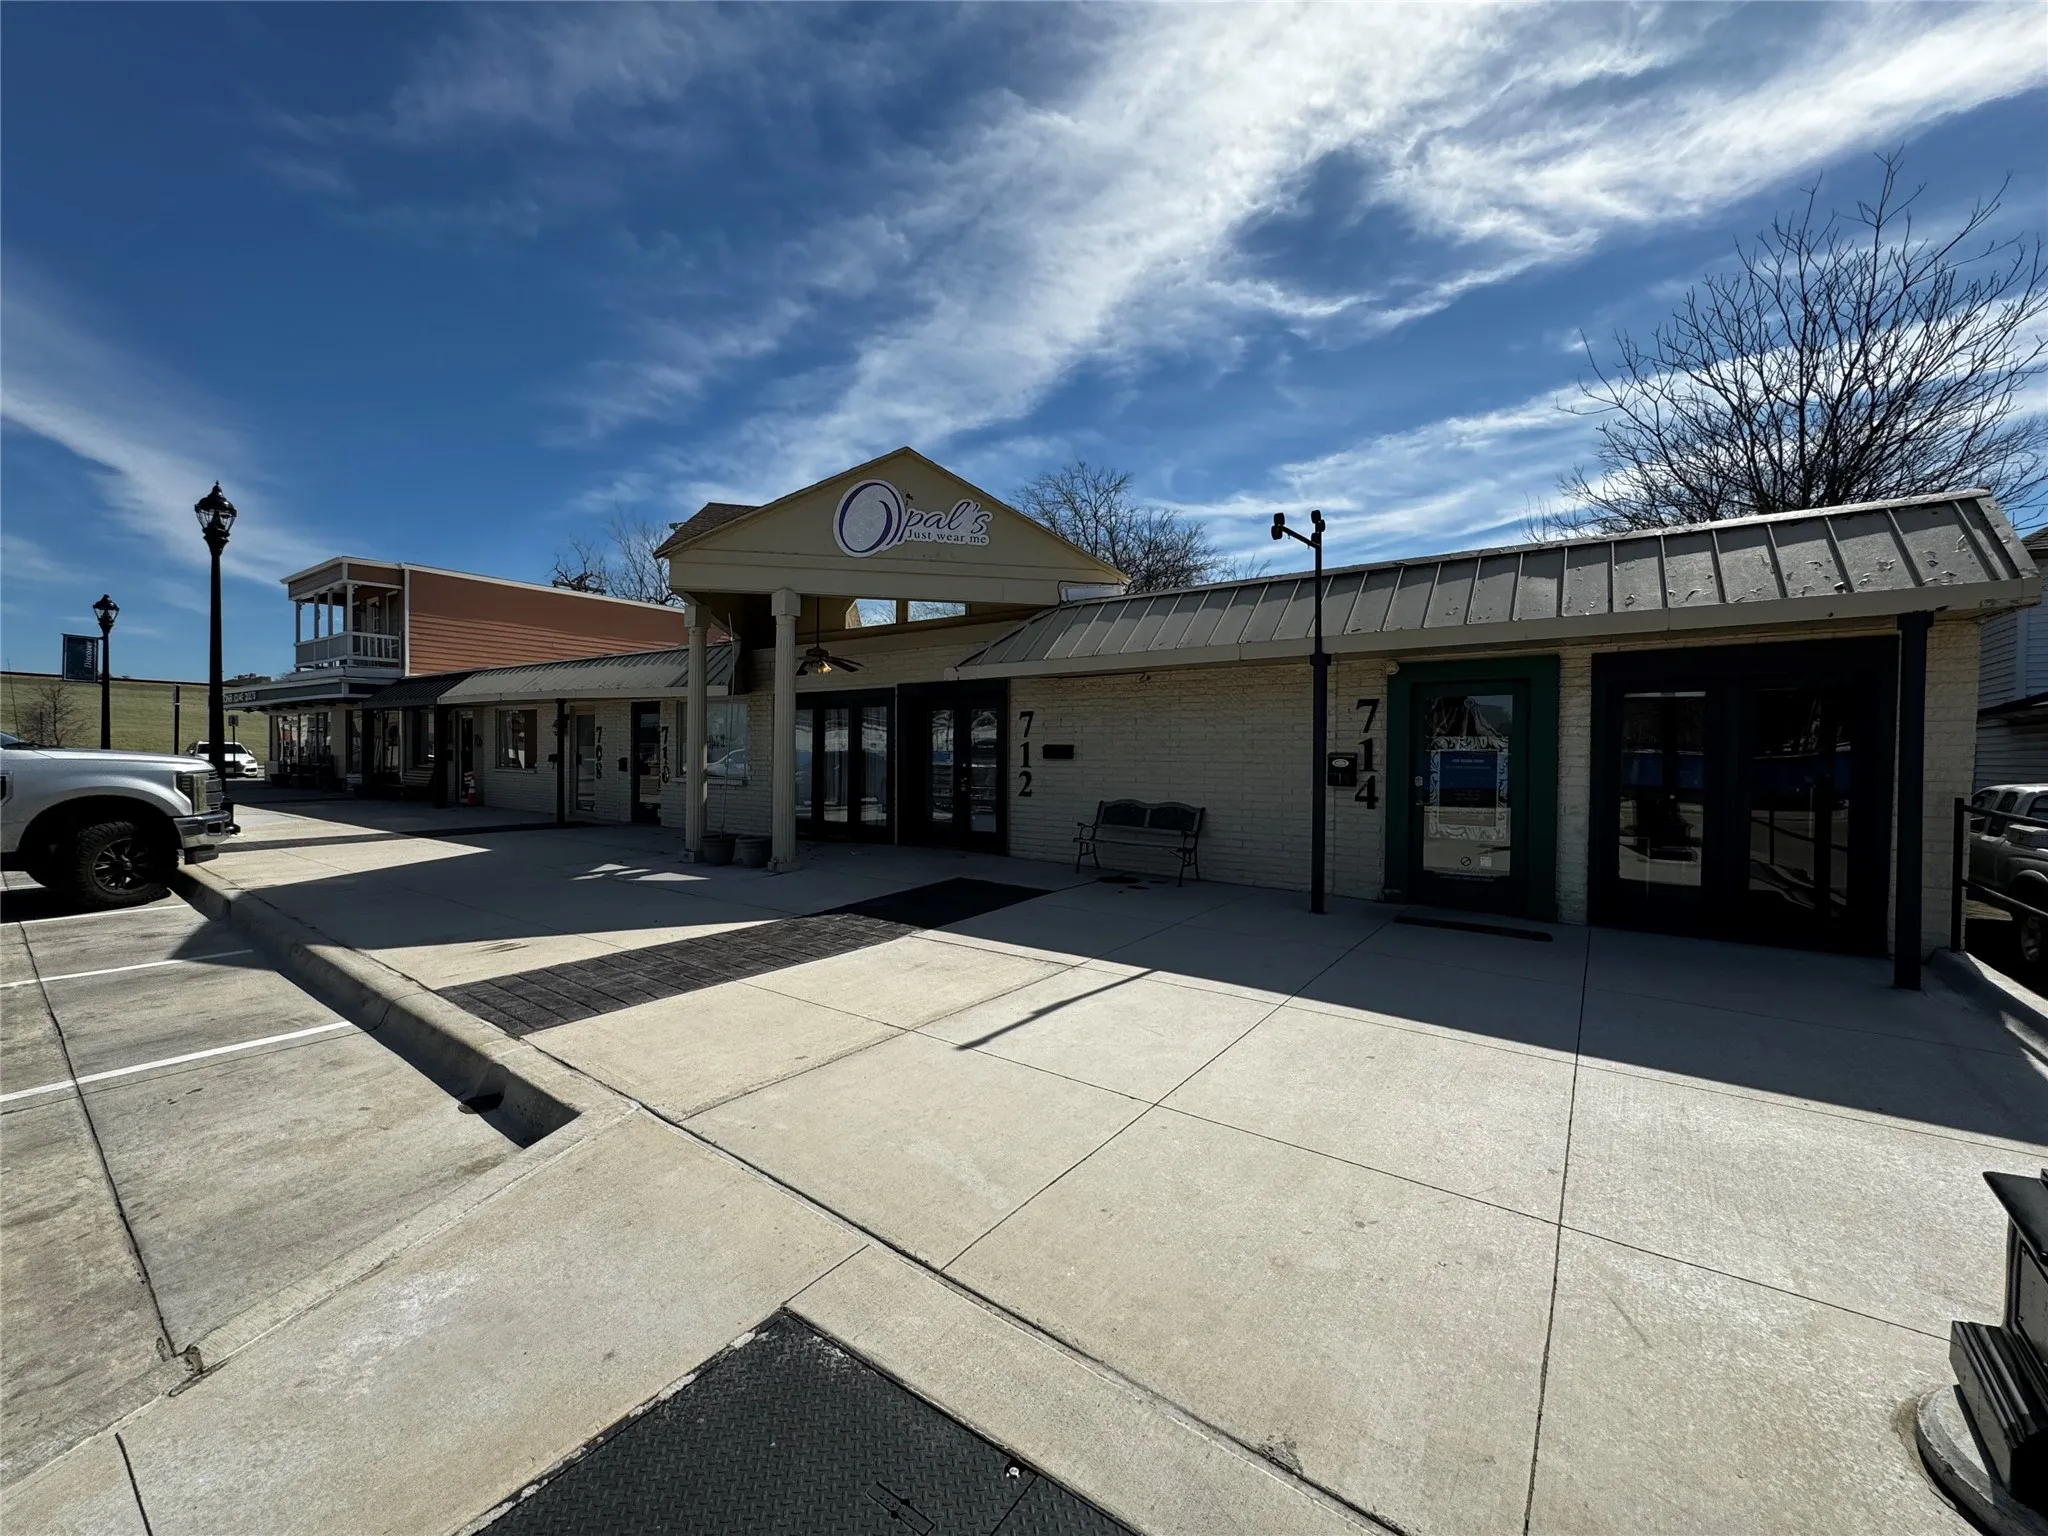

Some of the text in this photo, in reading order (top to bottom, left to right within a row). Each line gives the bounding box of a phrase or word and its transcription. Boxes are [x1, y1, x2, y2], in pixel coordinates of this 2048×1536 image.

[838, 482, 990, 553] Opal's
[907, 529, 987, 544] Just wear me
[595, 726, 603, 779] 708
[661, 726, 670, 783] 710
[1018, 711, 1034, 797] 712
[1354, 698, 1380, 809] 714
